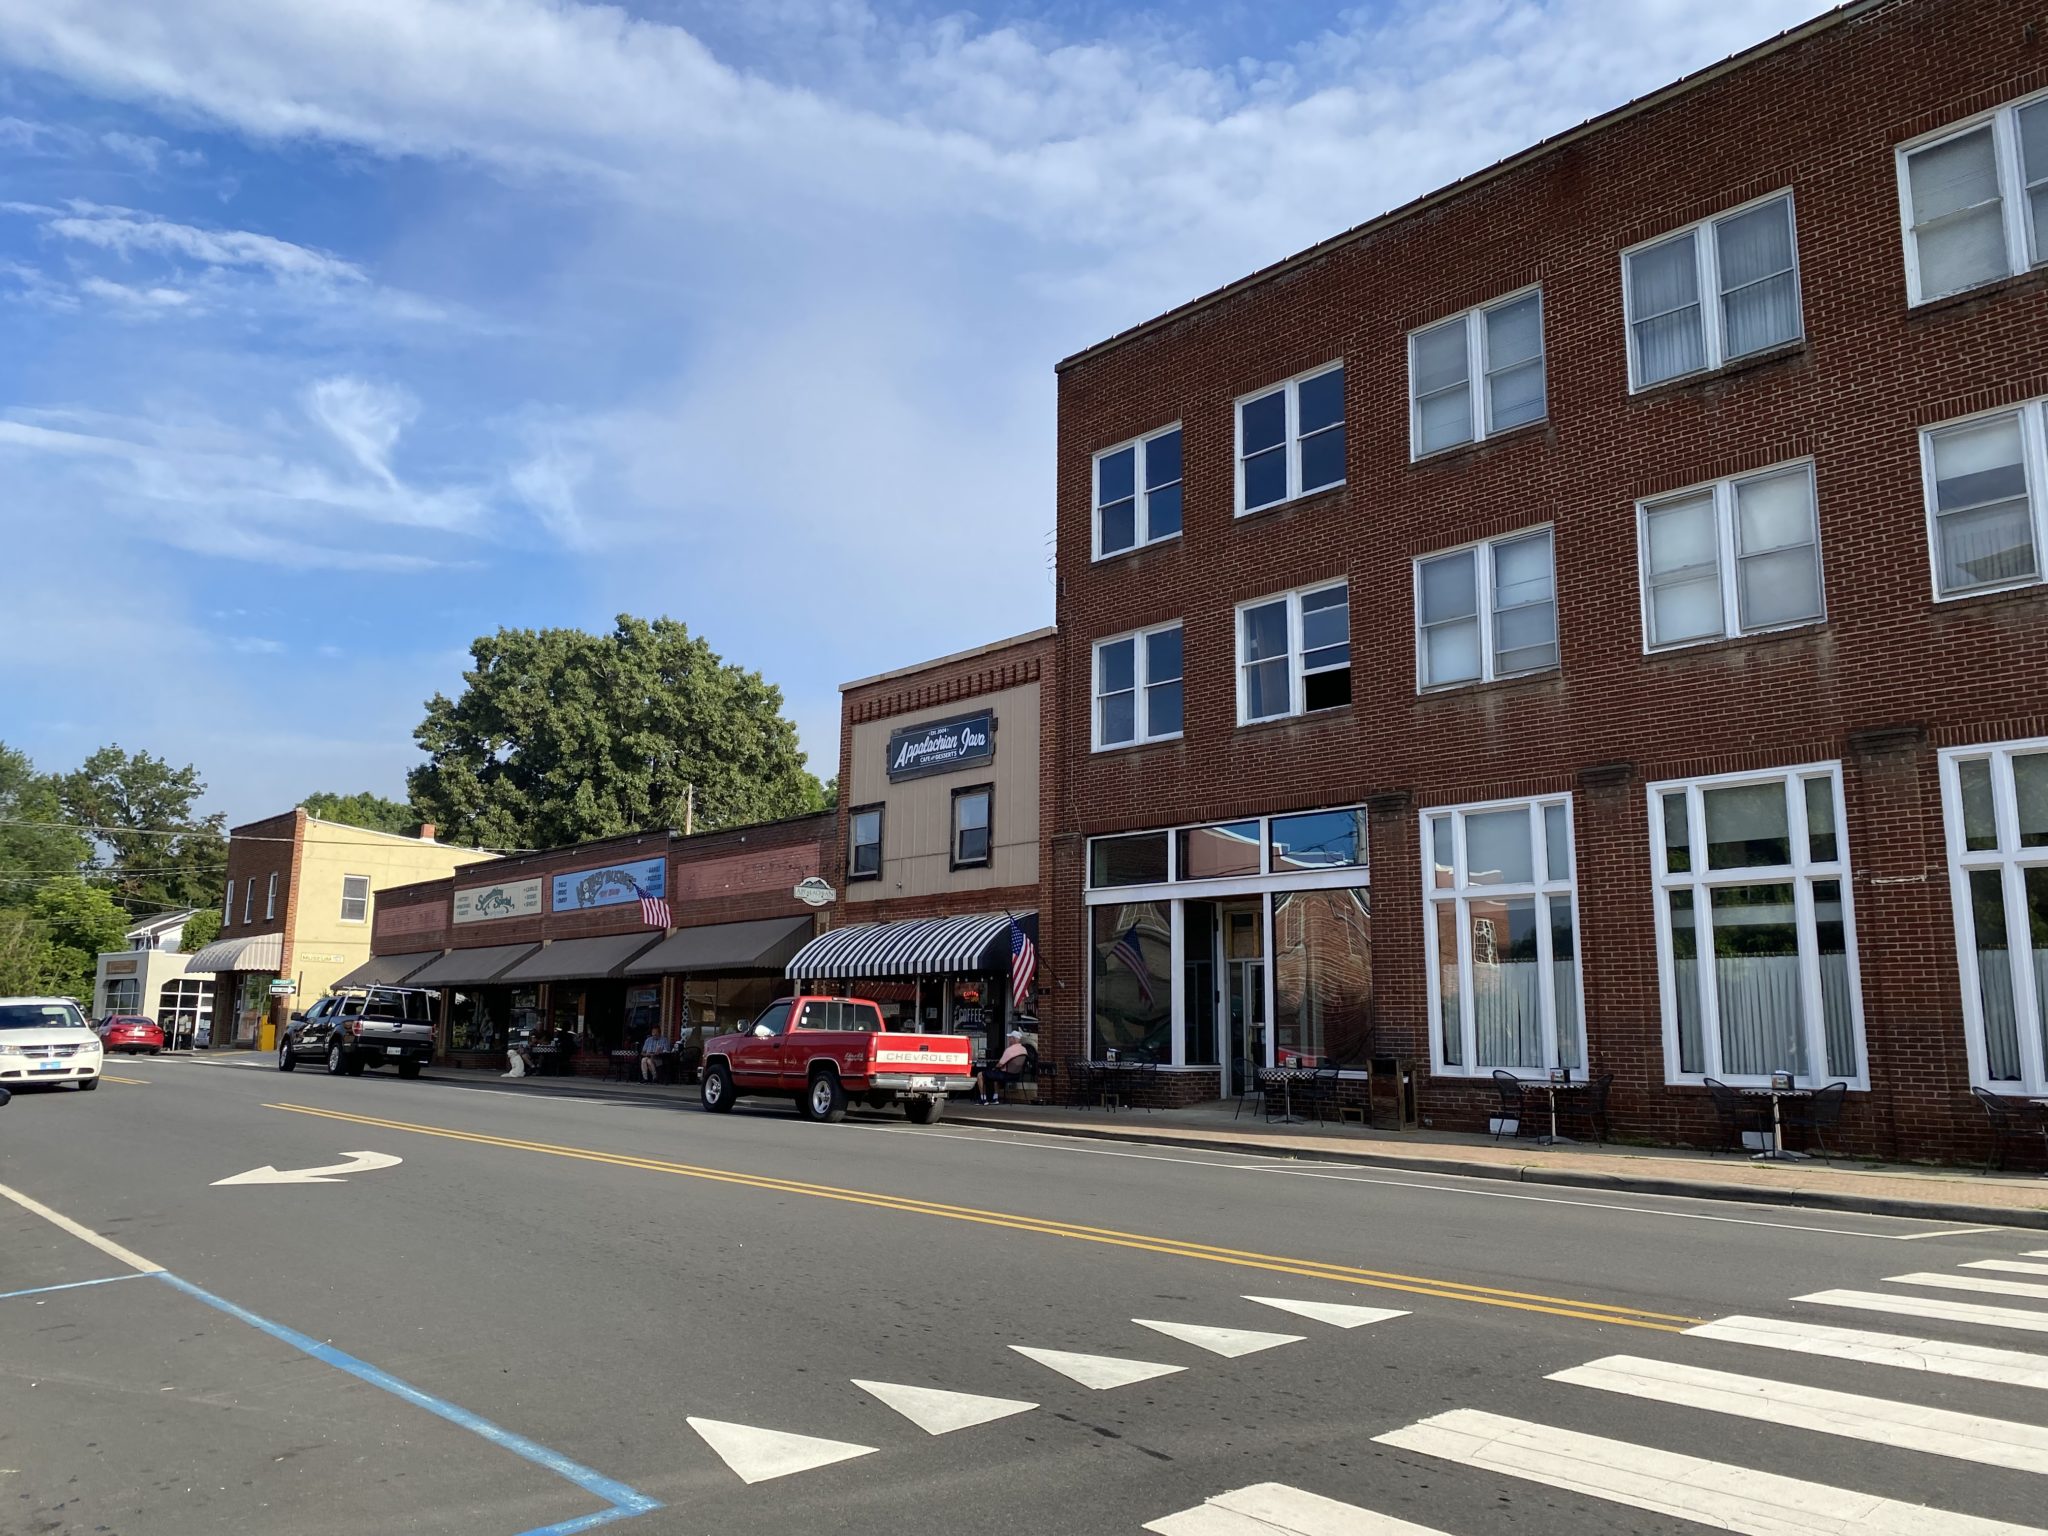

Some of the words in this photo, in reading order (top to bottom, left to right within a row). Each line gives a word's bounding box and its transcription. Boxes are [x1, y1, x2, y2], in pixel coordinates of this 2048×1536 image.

[893, 735, 958, 769] Appalachian
[959, 727, 986, 756] Java
[936, 751, 957, 760] DESSERTS
[959, 1008, 982, 1023] COFFEE
[886, 1052, 960, 1063] CHEVROLET
